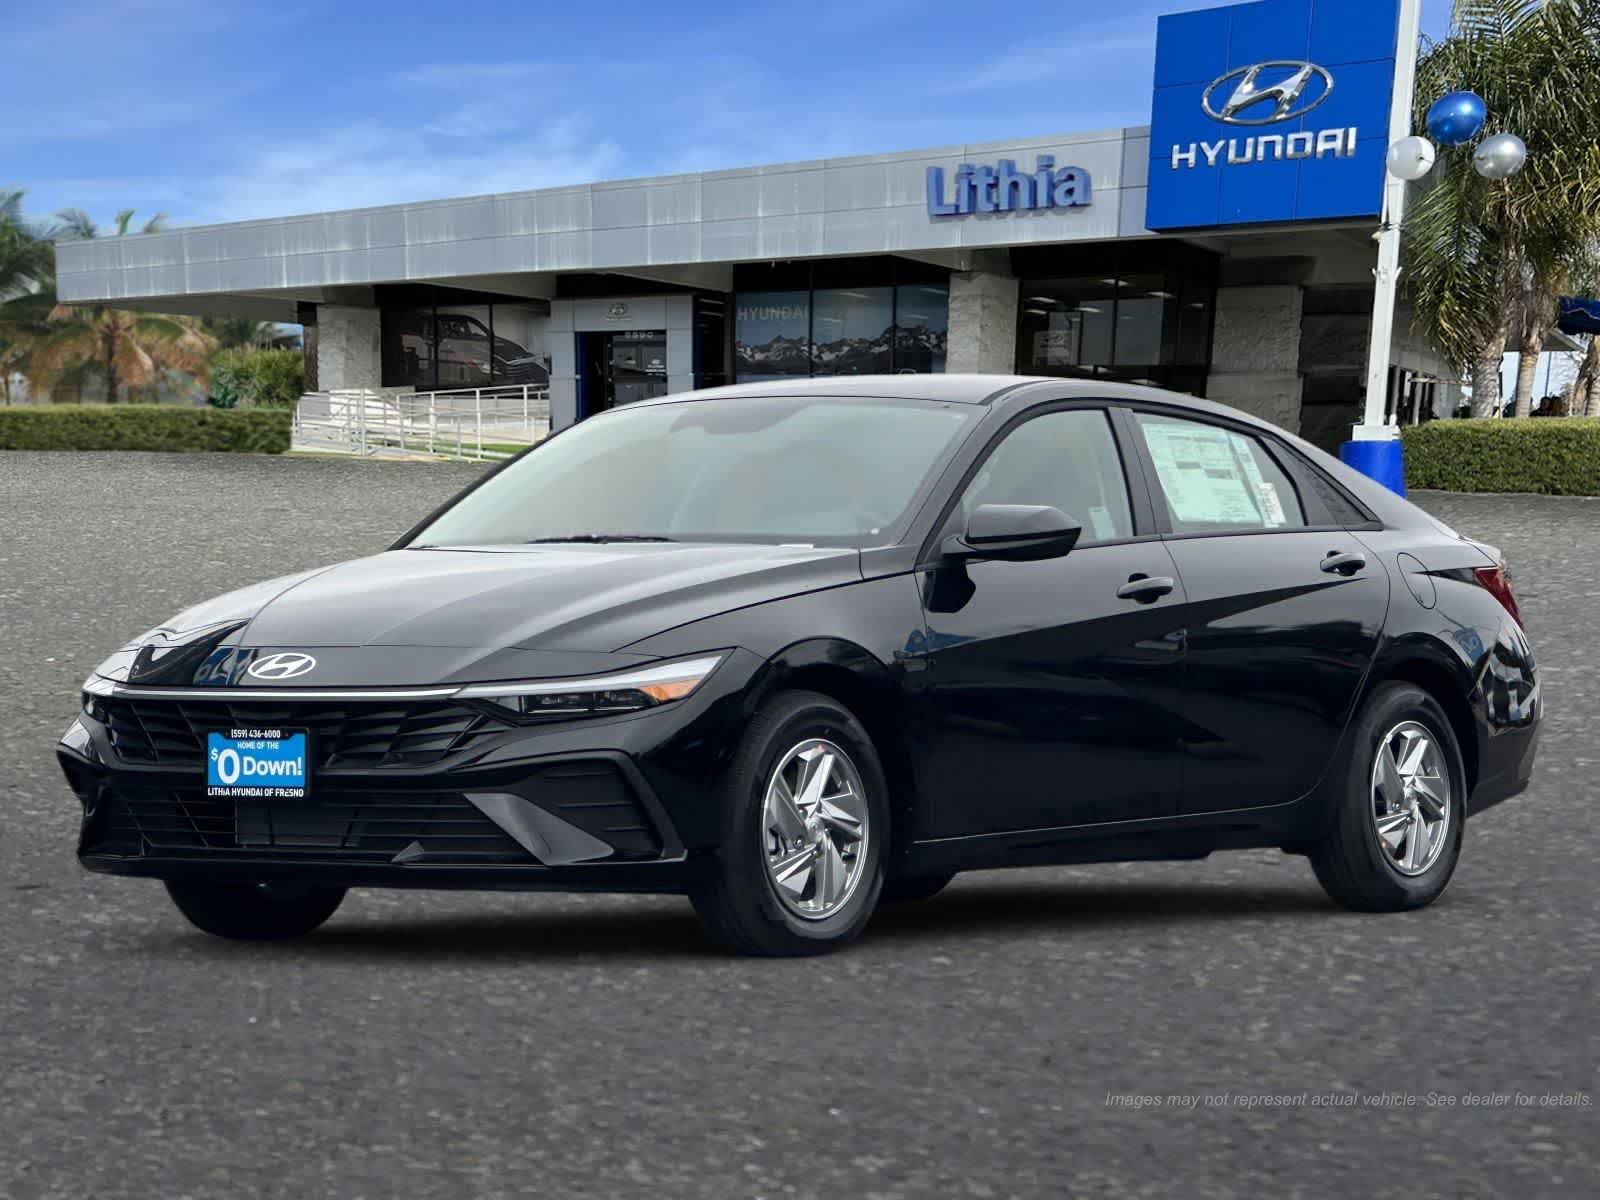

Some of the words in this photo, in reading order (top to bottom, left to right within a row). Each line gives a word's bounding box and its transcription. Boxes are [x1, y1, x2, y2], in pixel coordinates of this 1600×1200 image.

[1170, 127, 1359, 169] HYUNDAI
[926, 154, 1092, 216] Lithia
[737, 305, 809, 321] HYUNDAI
[231, 729, 248, 738] (559)
[249, 729, 281, 738] 436-6000
[237, 741, 255, 749] HOME
[257, 741, 265, 749] OF
[267, 741, 279, 750] THE
[210, 747, 240, 784] $0
[243, 756, 303, 776] Down!
[231, 787, 263, 797] HYUNDAI
[264, 787, 274, 797] OF
